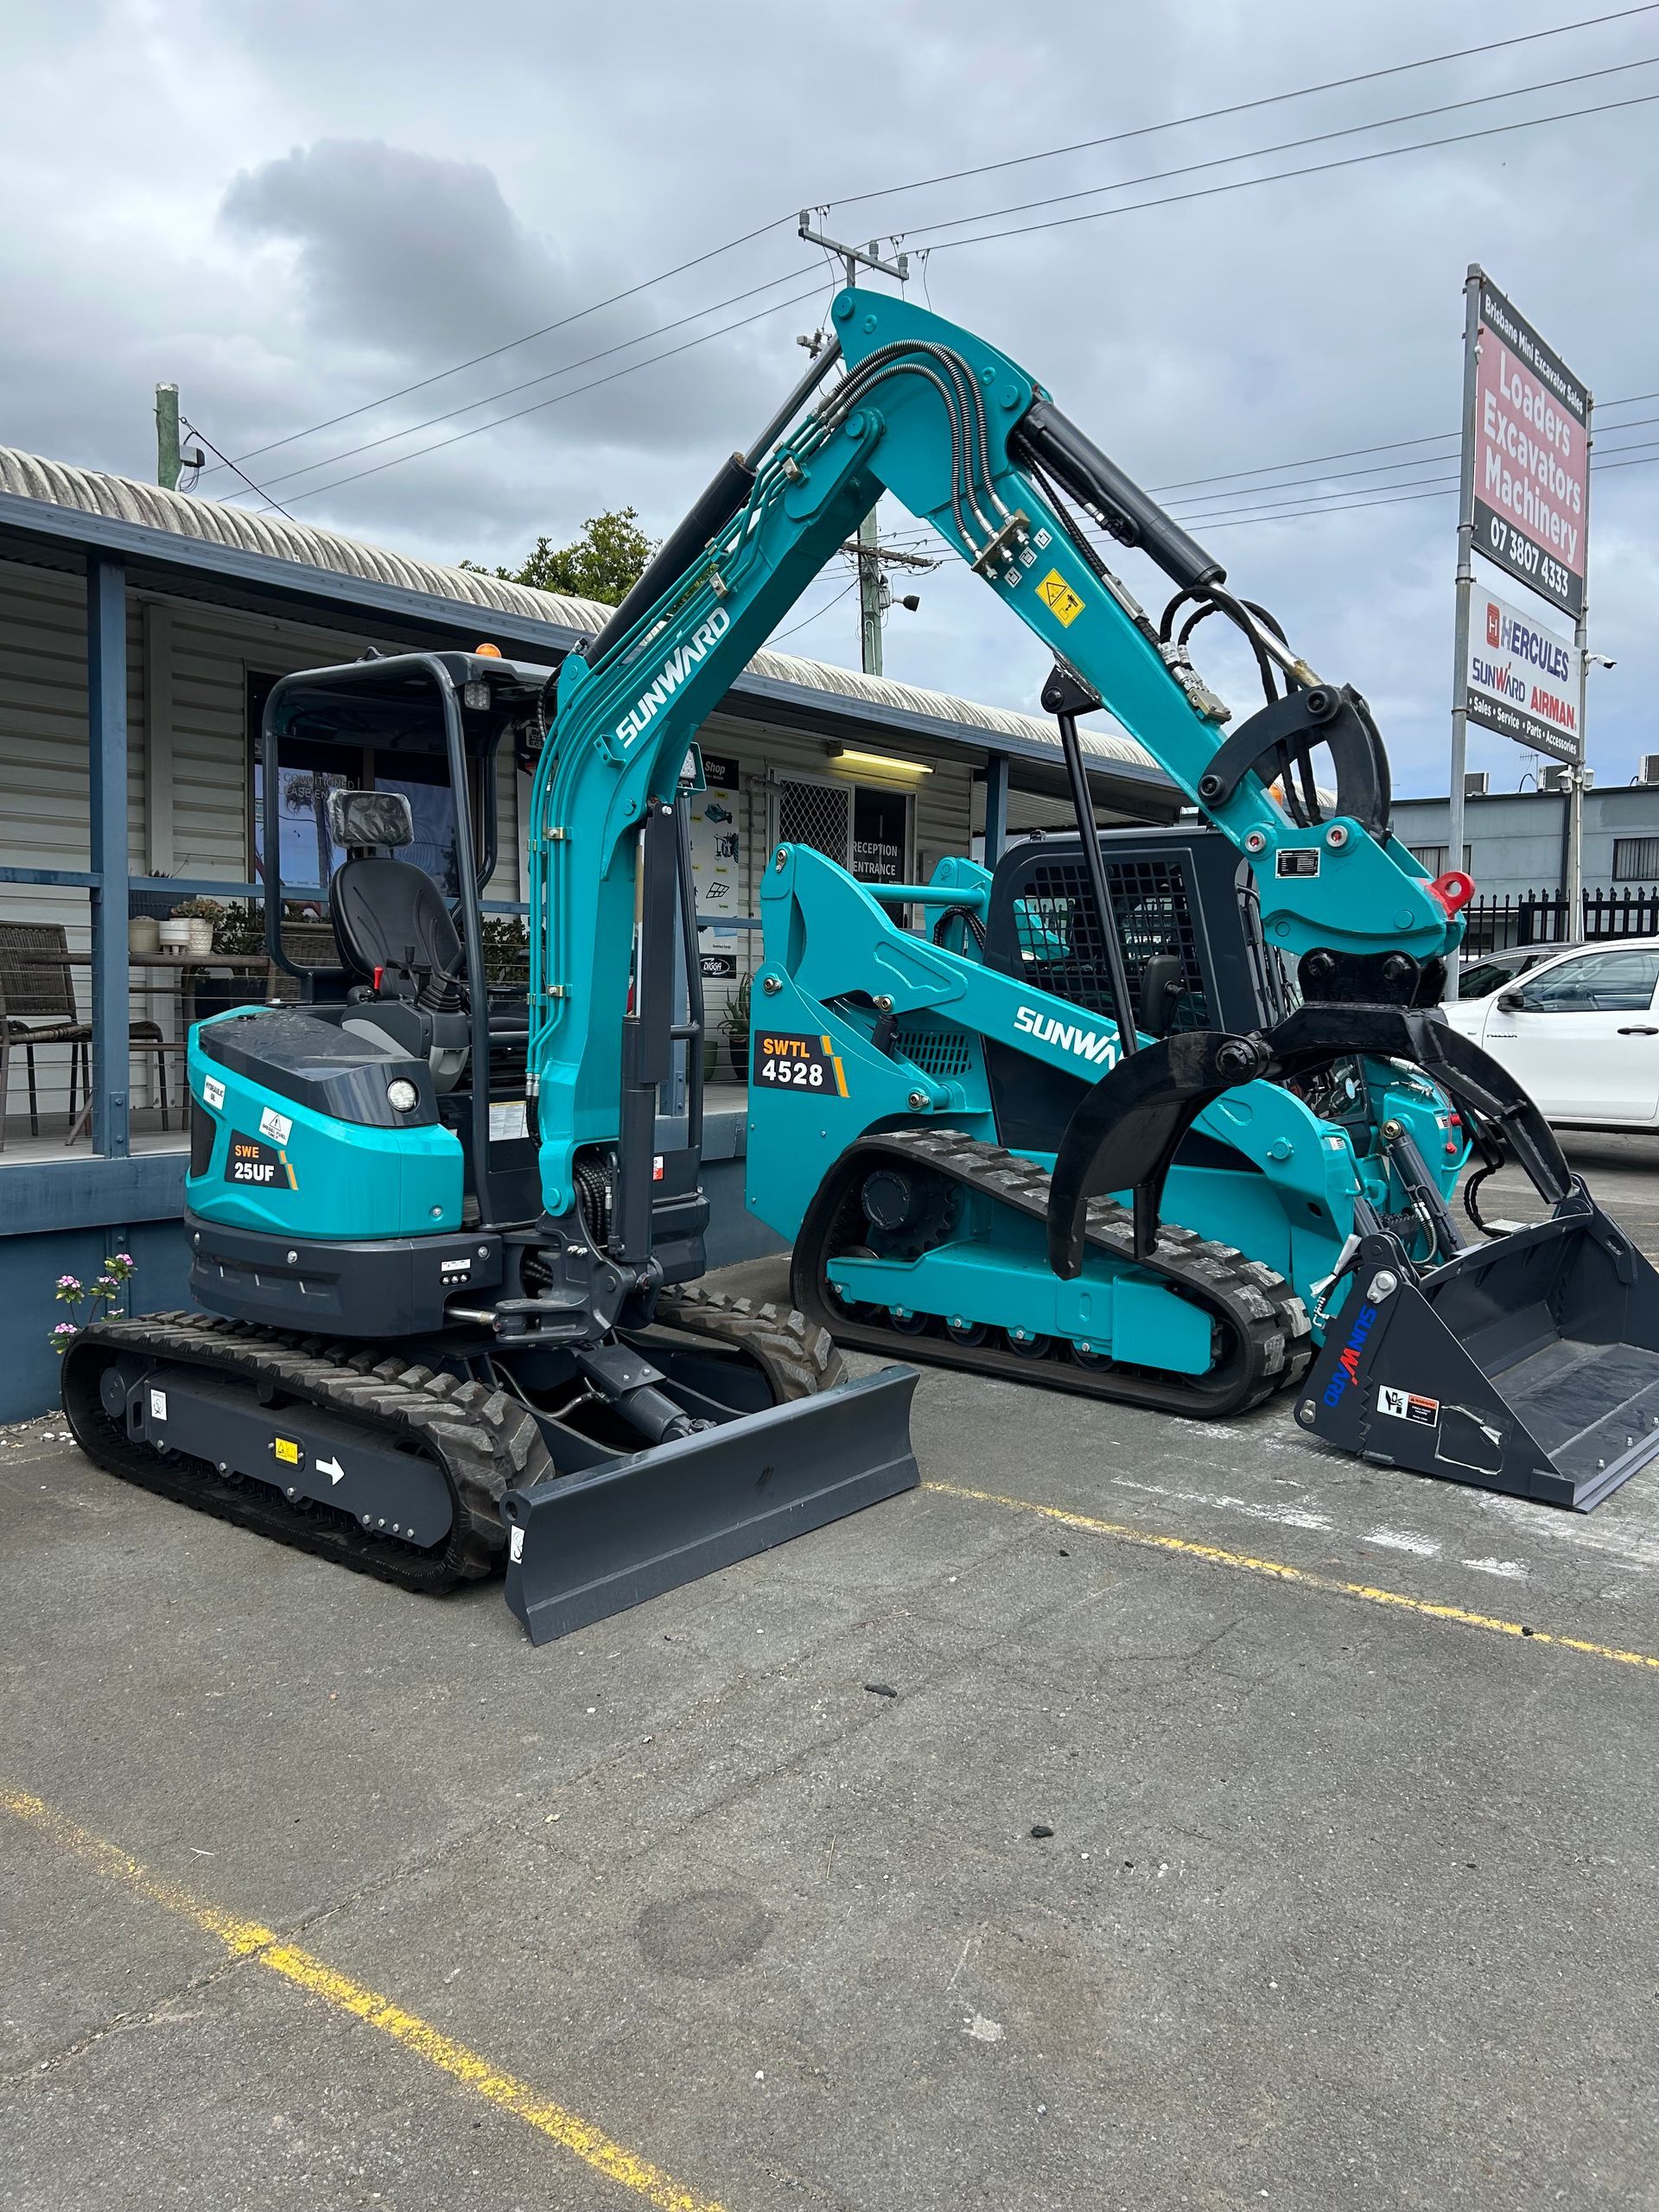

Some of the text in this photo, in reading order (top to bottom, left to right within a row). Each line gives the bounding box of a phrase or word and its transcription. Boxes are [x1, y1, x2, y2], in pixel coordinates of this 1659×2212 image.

[1484, 294, 1584, 415] Brisbane Mini Excavator Sales
[1500, 350, 1570, 457] Loaders
[1484, 389, 1581, 514] Excavators
[1484, 446, 1578, 563] Machinery
[1491, 517, 1569, 597] 07 3807 4333
[615, 607, 730, 749] SUNWARD
[1501, 614, 1569, 683] HERCULES
[1472, 657, 1526, 703] SUNWARD
[1473, 696, 1577, 755] Sales Service Parts Accessories
[705, 760, 726, 776] Shop
[853, 841, 898, 857] RECEPTION
[853, 861, 896, 876] ENTRANCE
[762, 1038, 810, 1058] SWTL
[1014, 1005, 1124, 1071] SUNWA
[206, 1082, 224, 1097] HYDRAULIC
[761, 1059, 824, 1086] 4528
[234, 1145, 260, 1160] SWE
[234, 1161, 276, 1182] 25UF
[1323, 1304, 1376, 1408] SUNWARD
